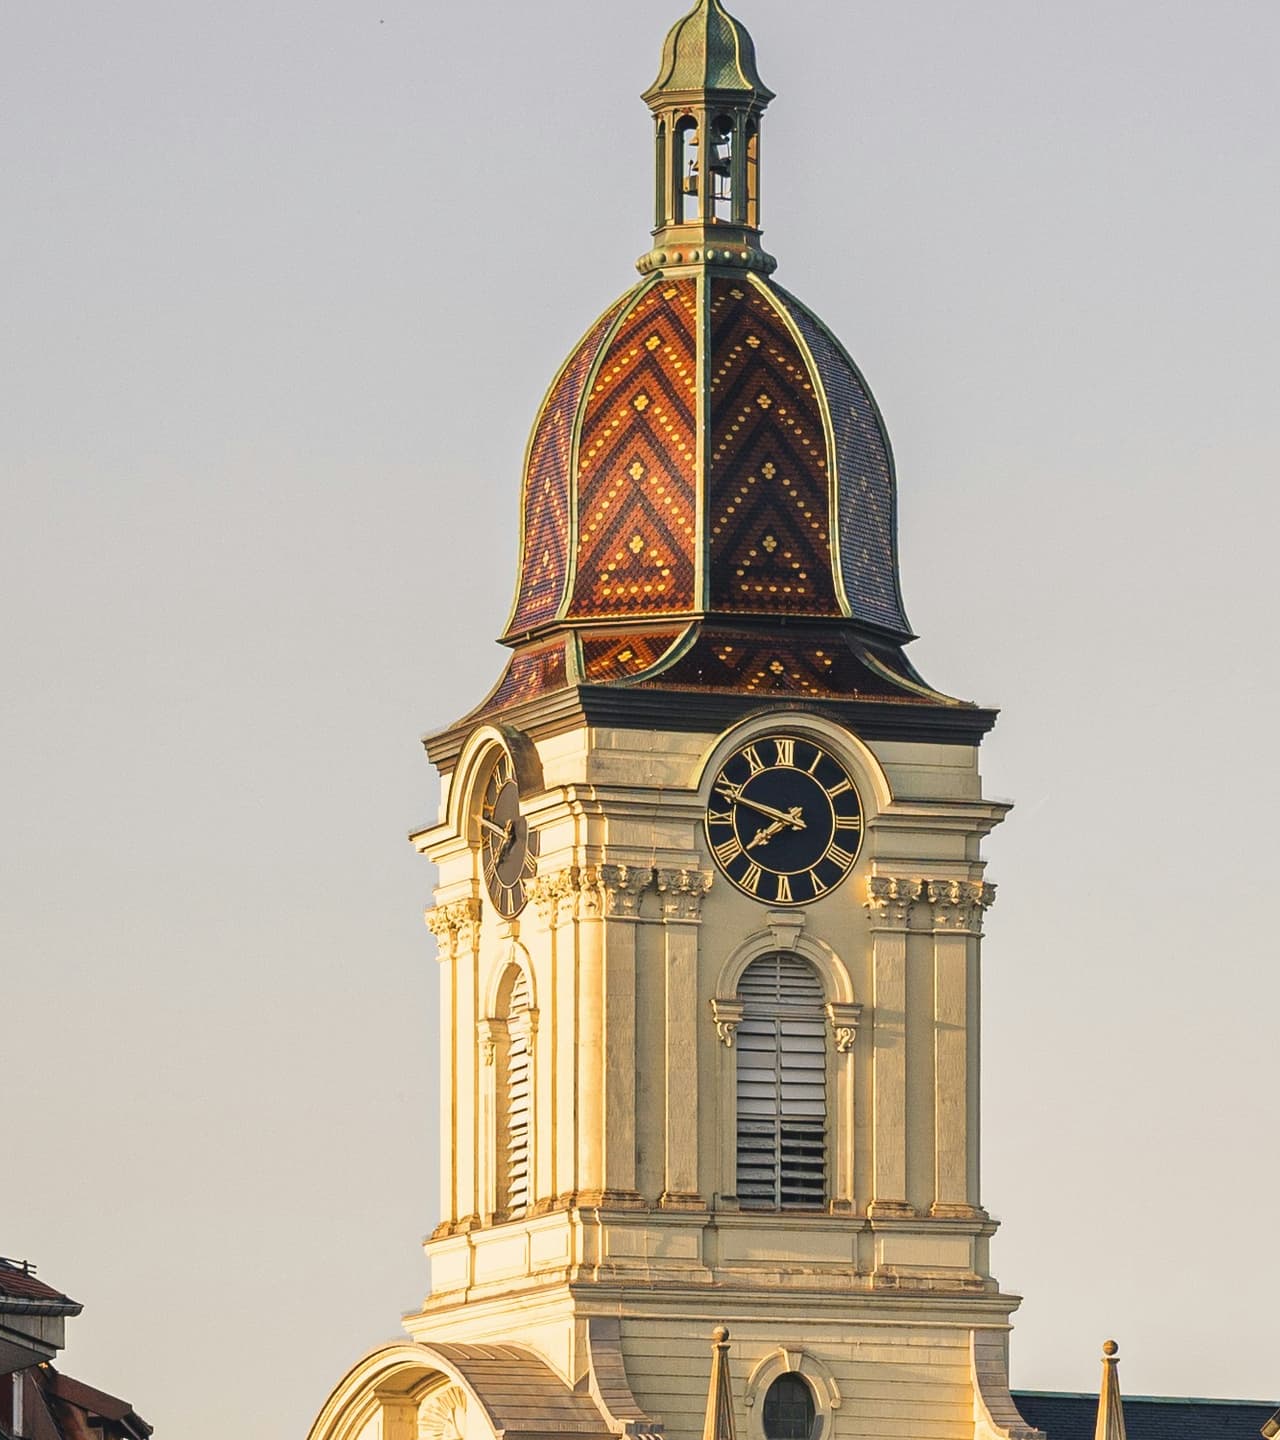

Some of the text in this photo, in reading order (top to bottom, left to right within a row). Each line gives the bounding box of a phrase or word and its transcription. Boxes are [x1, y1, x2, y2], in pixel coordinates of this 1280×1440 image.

[741, 744, 765, 776] XI
[773, 739, 796, 766] XII
[827, 777, 853, 799] II
[835, 816, 860, 830] III
[738, 864, 762, 894] VII
[776, 875, 793, 902] VI
[809, 869, 829, 895] V
